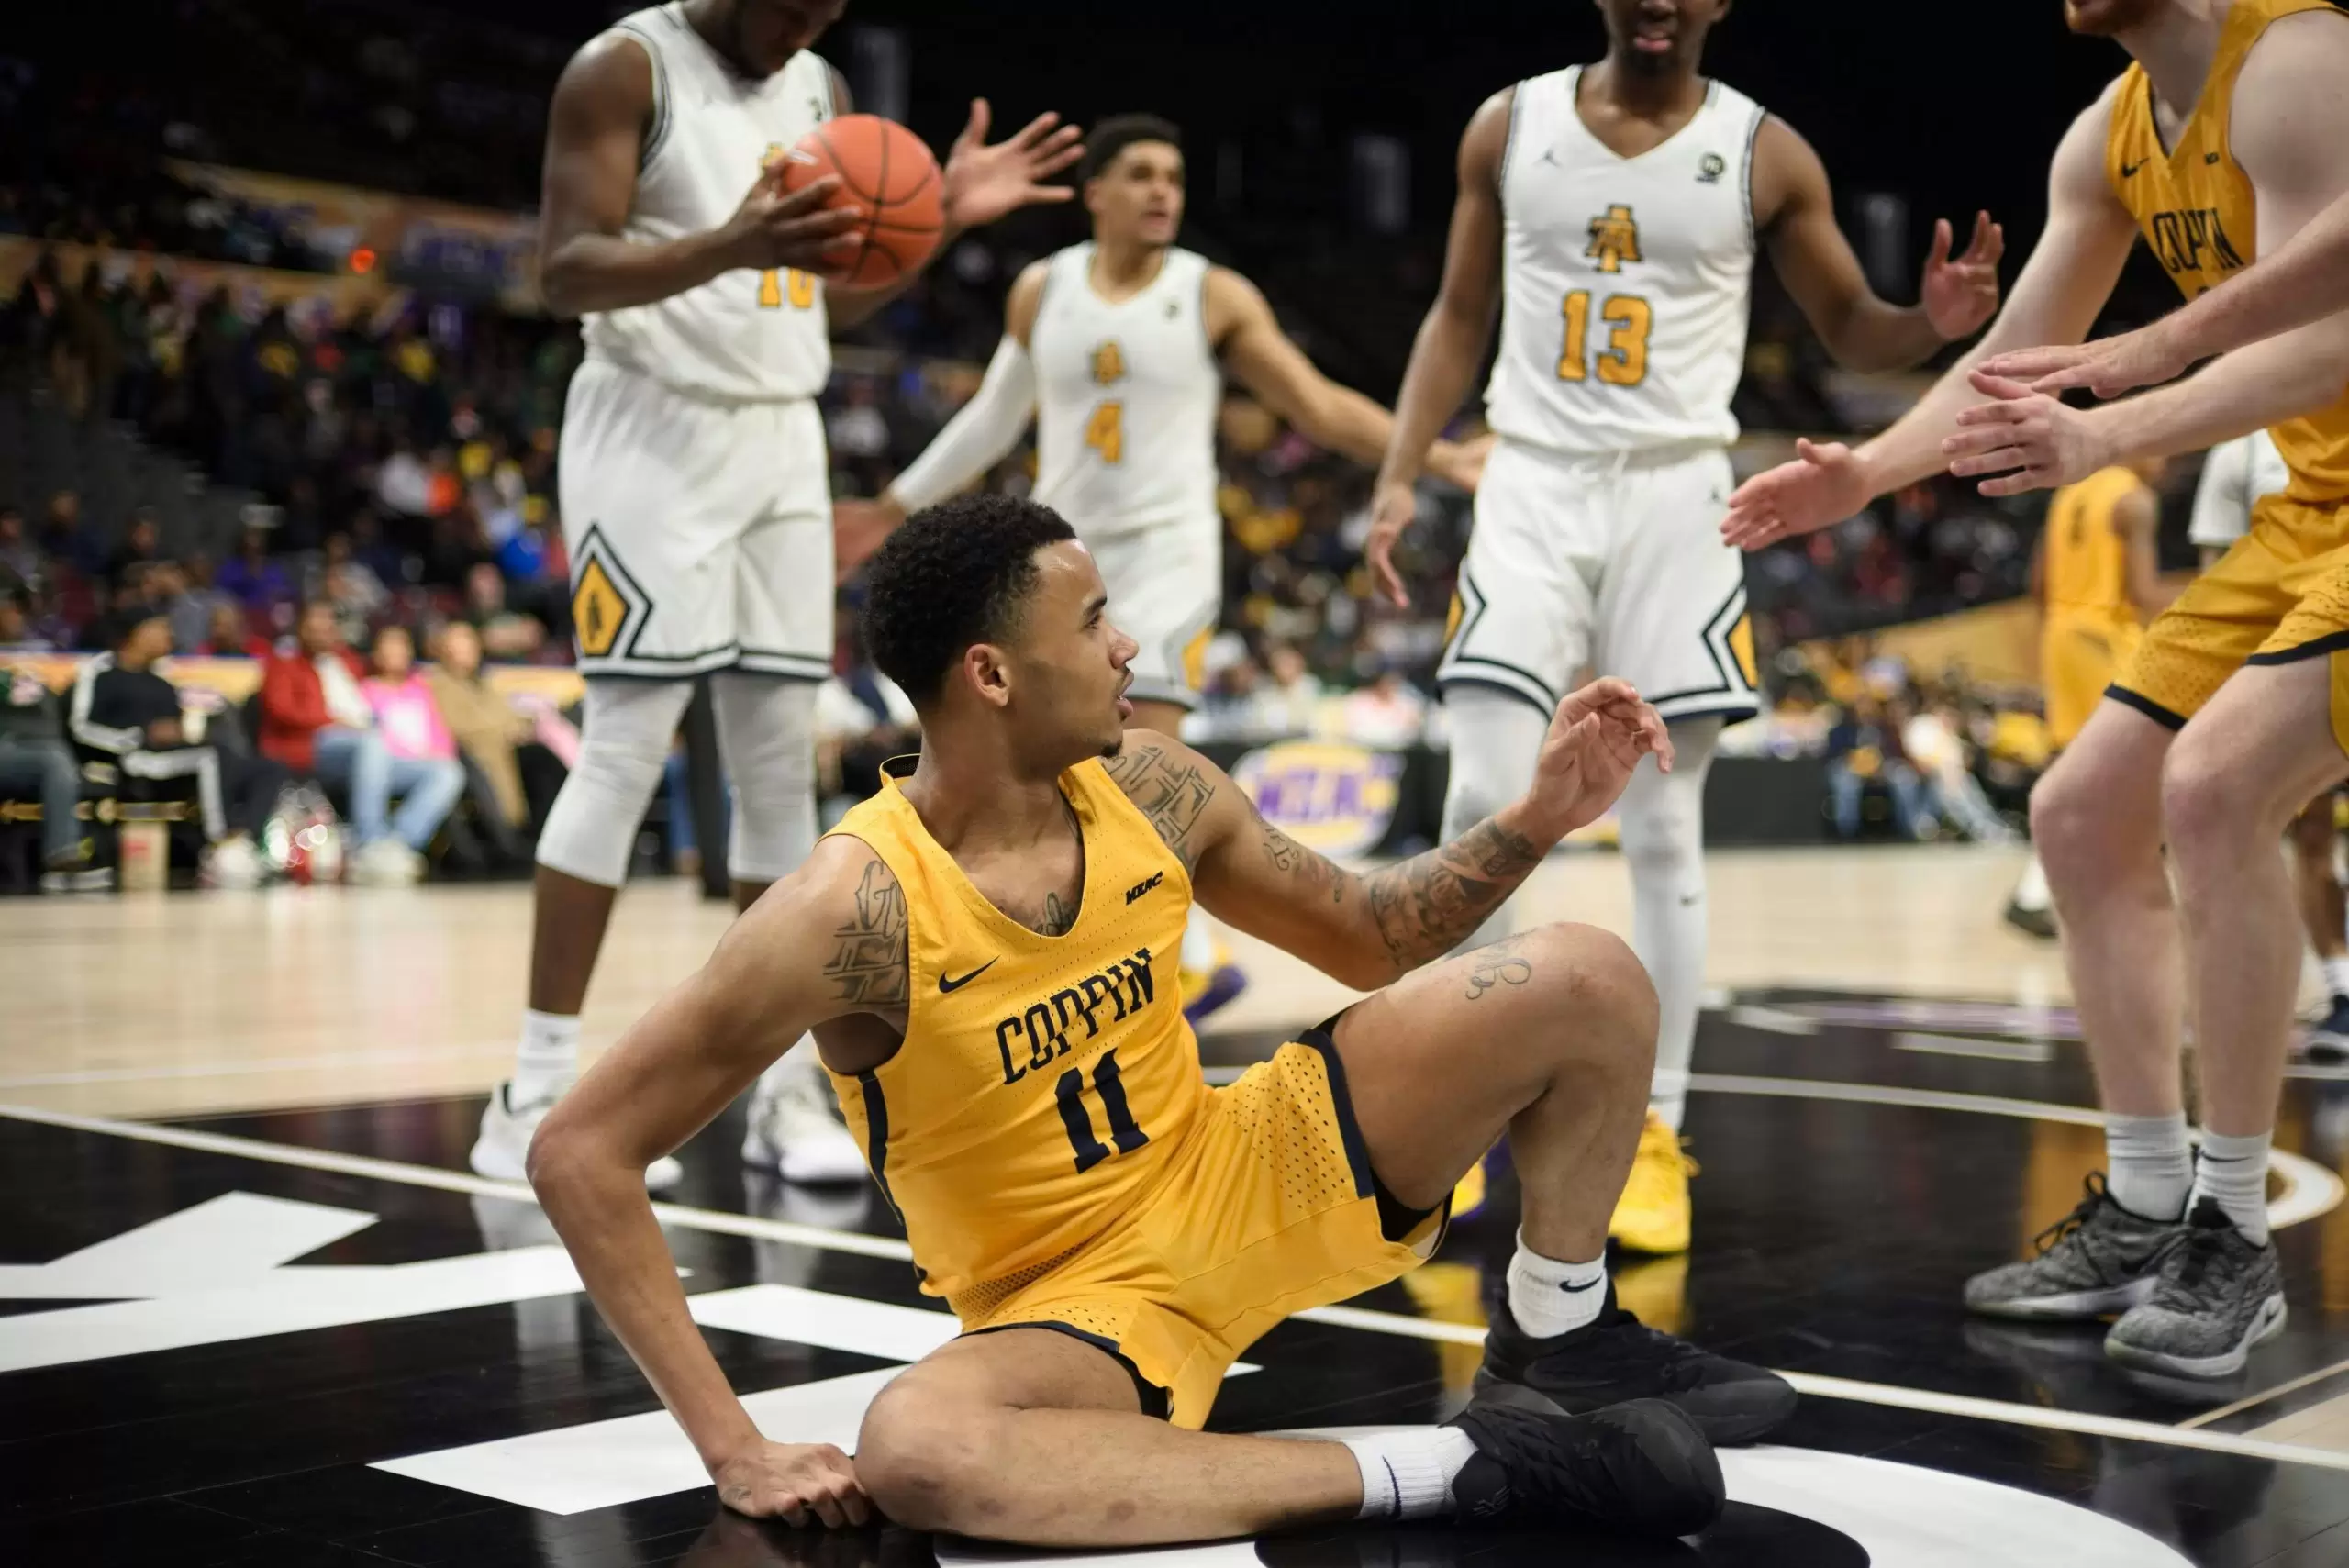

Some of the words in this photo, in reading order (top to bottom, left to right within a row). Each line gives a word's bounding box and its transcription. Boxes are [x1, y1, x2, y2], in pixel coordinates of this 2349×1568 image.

[1557, 289, 1653, 387] 13
[1085, 400, 1125, 466] 4
[1126, 870, 1163, 906] MEAC
[996, 947, 1154, 1085] COPPIN
[1054, 1047, 1150, 1175] 11
